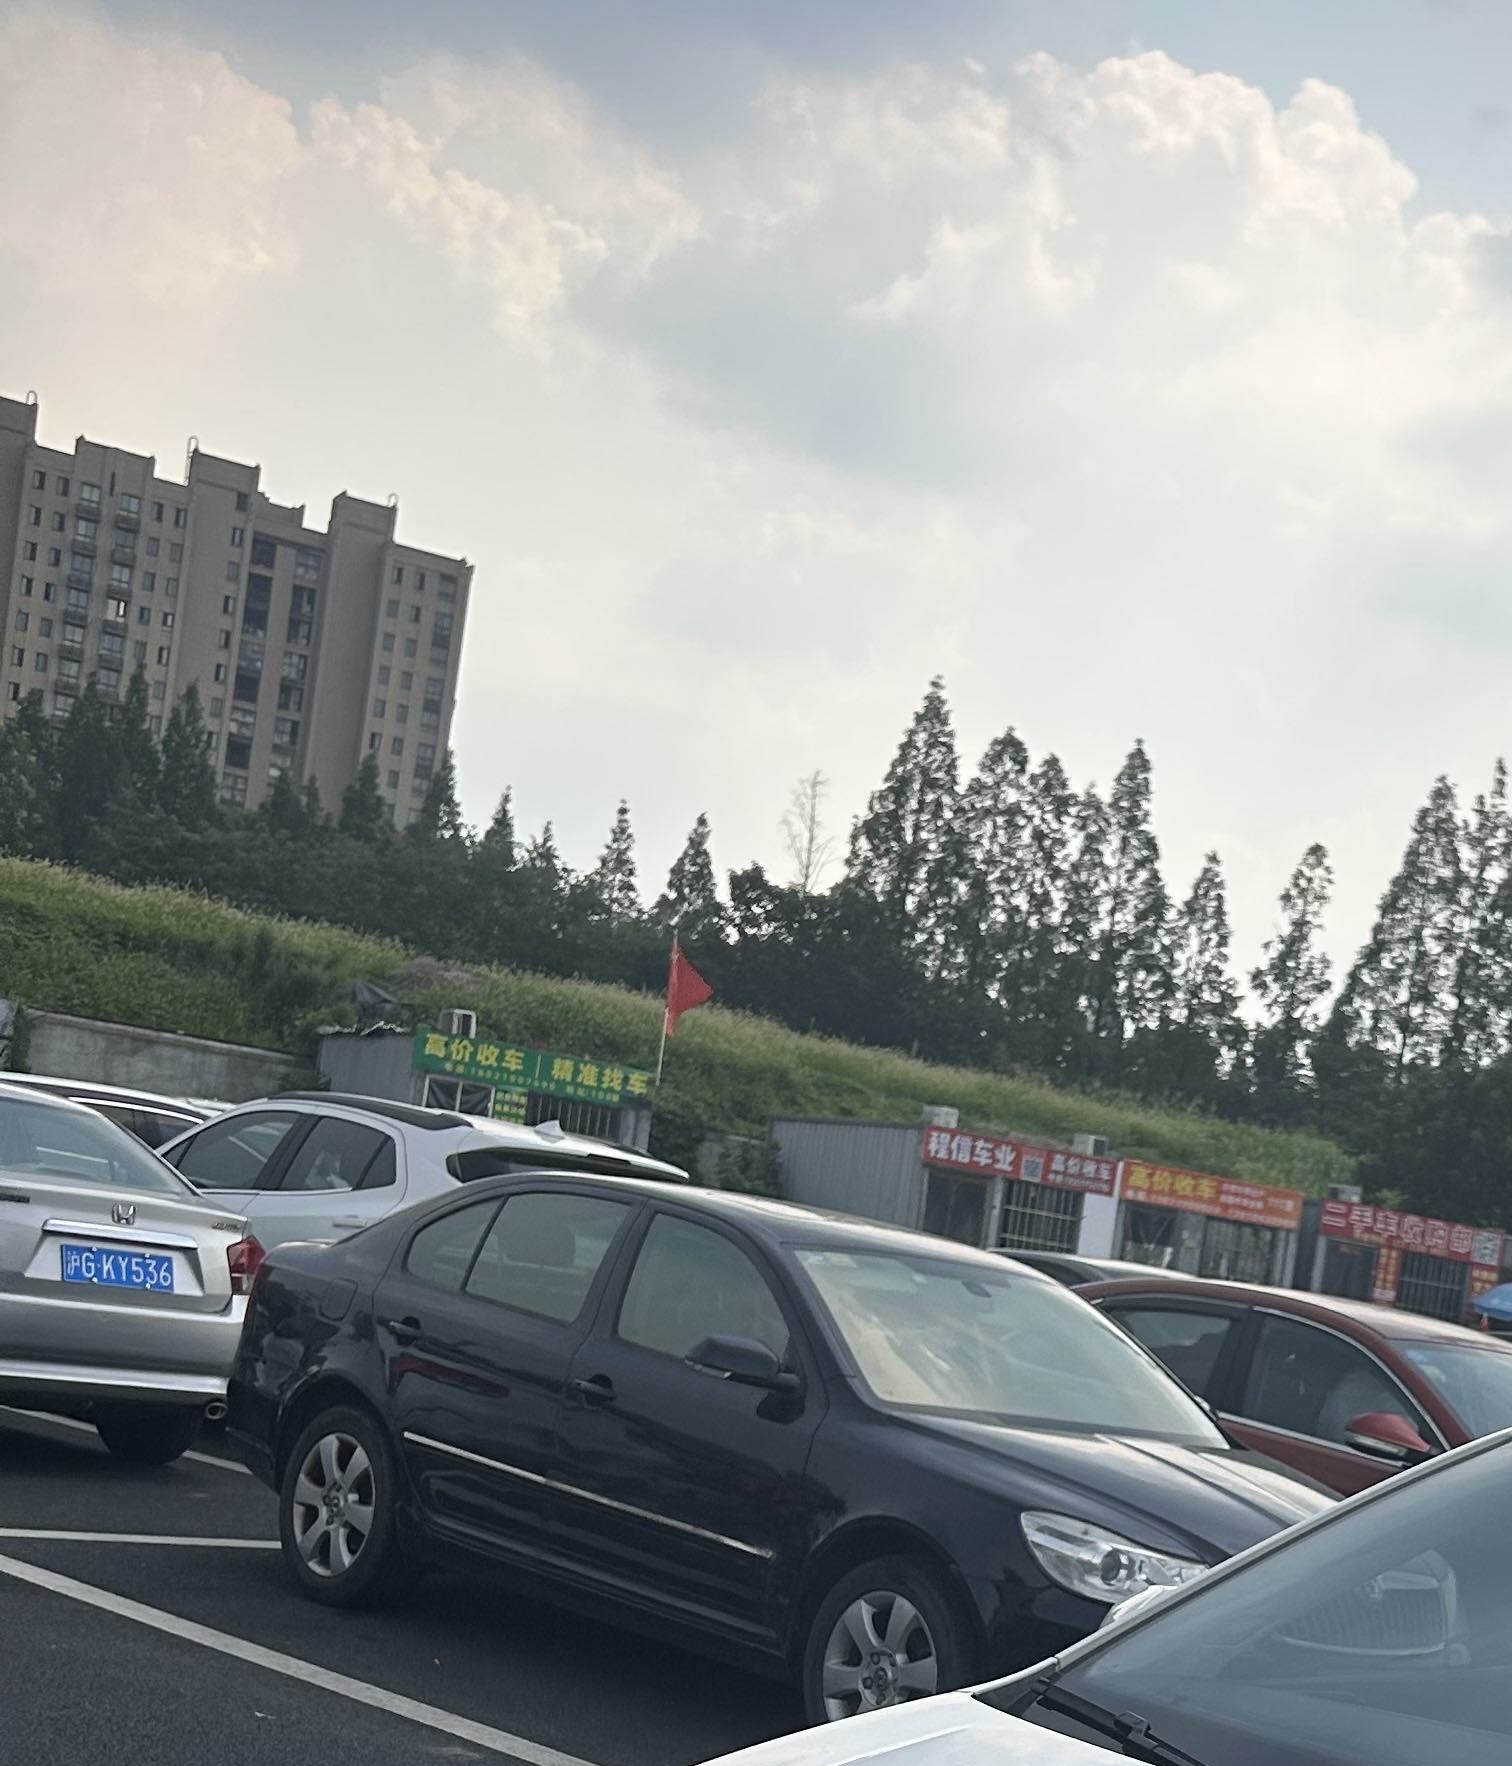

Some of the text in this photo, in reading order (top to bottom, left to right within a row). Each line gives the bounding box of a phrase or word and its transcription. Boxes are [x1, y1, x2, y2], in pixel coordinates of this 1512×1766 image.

[424, 1032, 525, 1072] 高价收车
[1127, 1163, 1219, 1199] 高价收车
